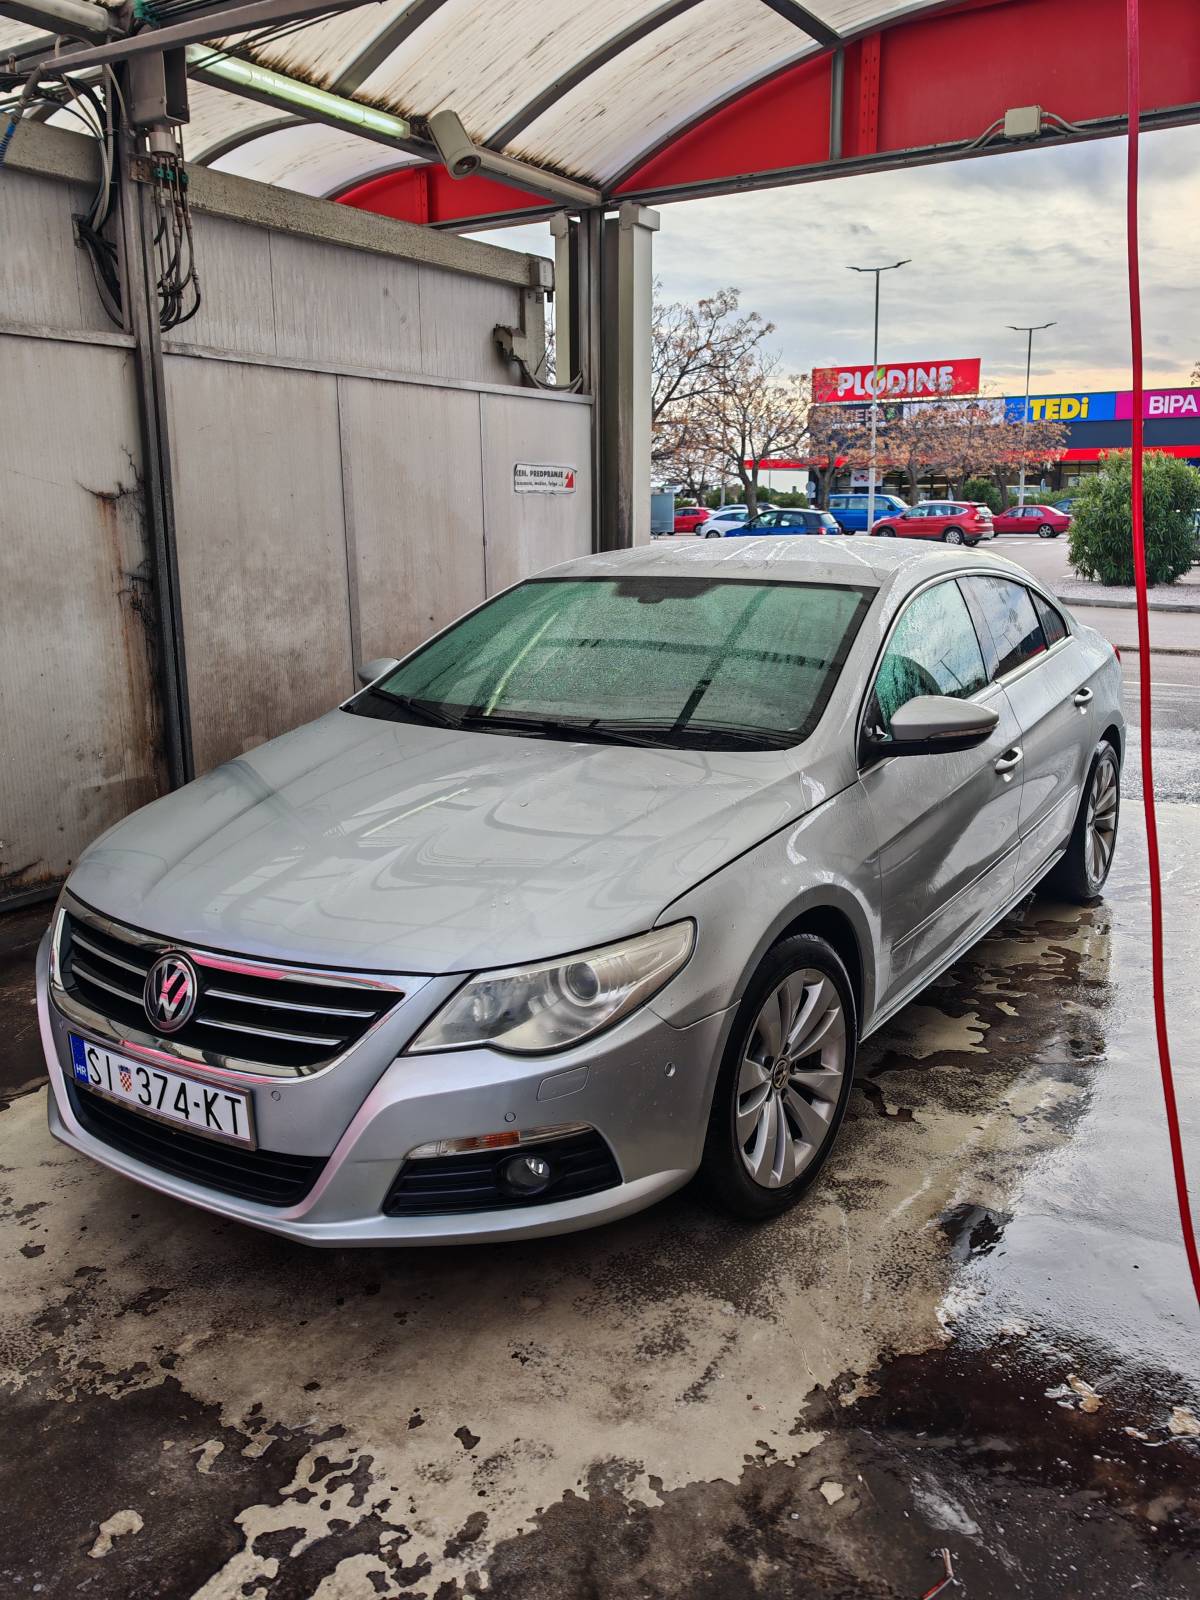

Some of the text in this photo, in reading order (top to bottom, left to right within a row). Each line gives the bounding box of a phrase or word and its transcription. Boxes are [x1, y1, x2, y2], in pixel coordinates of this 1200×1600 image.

[837, 366, 954, 397] PLODINE
[1029, 397, 1089, 421] TEDi
[1148, 394, 1198, 415] BIPA
[76, 1063, 87, 1077] HR
[136, 1067, 242, 1135] 374-KT
